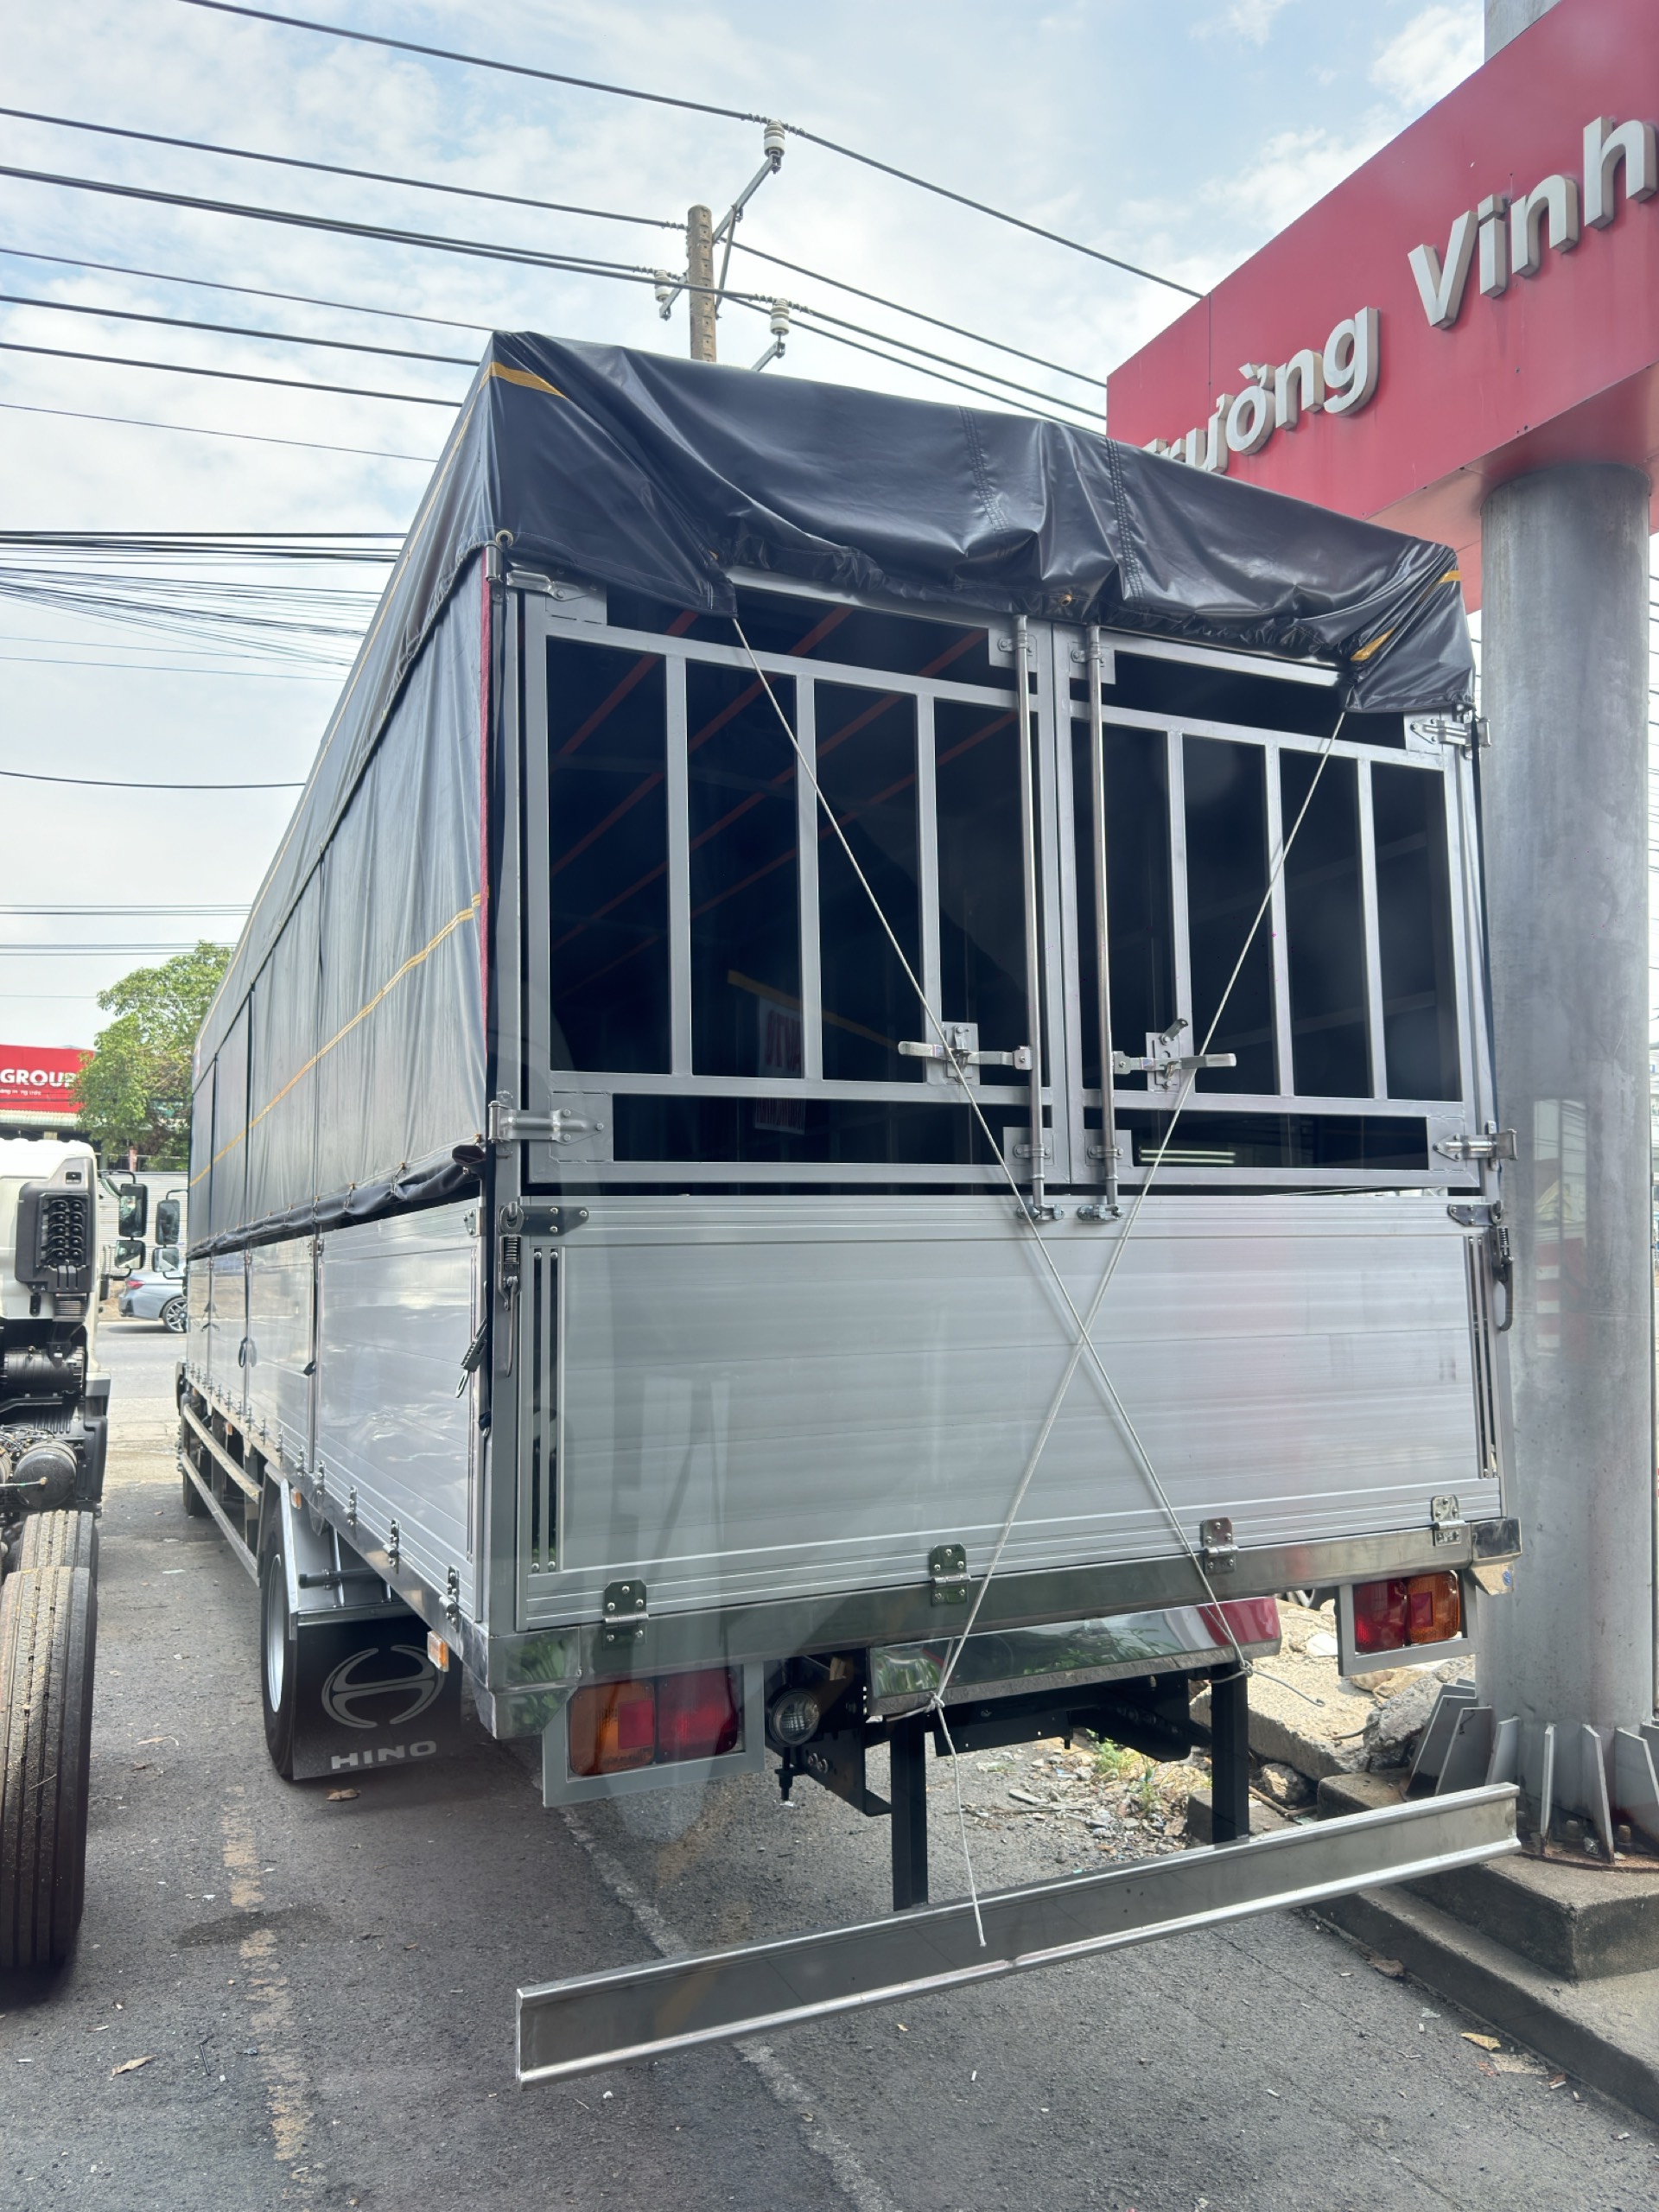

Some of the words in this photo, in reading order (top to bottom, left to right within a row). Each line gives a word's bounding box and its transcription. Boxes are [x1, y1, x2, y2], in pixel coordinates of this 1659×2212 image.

[1142, 306, 1380, 475] ường
[1408, 116, 1657, 330] Vinh
[0, 1068, 76, 1088] GROUP
[331, 1740, 436, 1770] HINO
